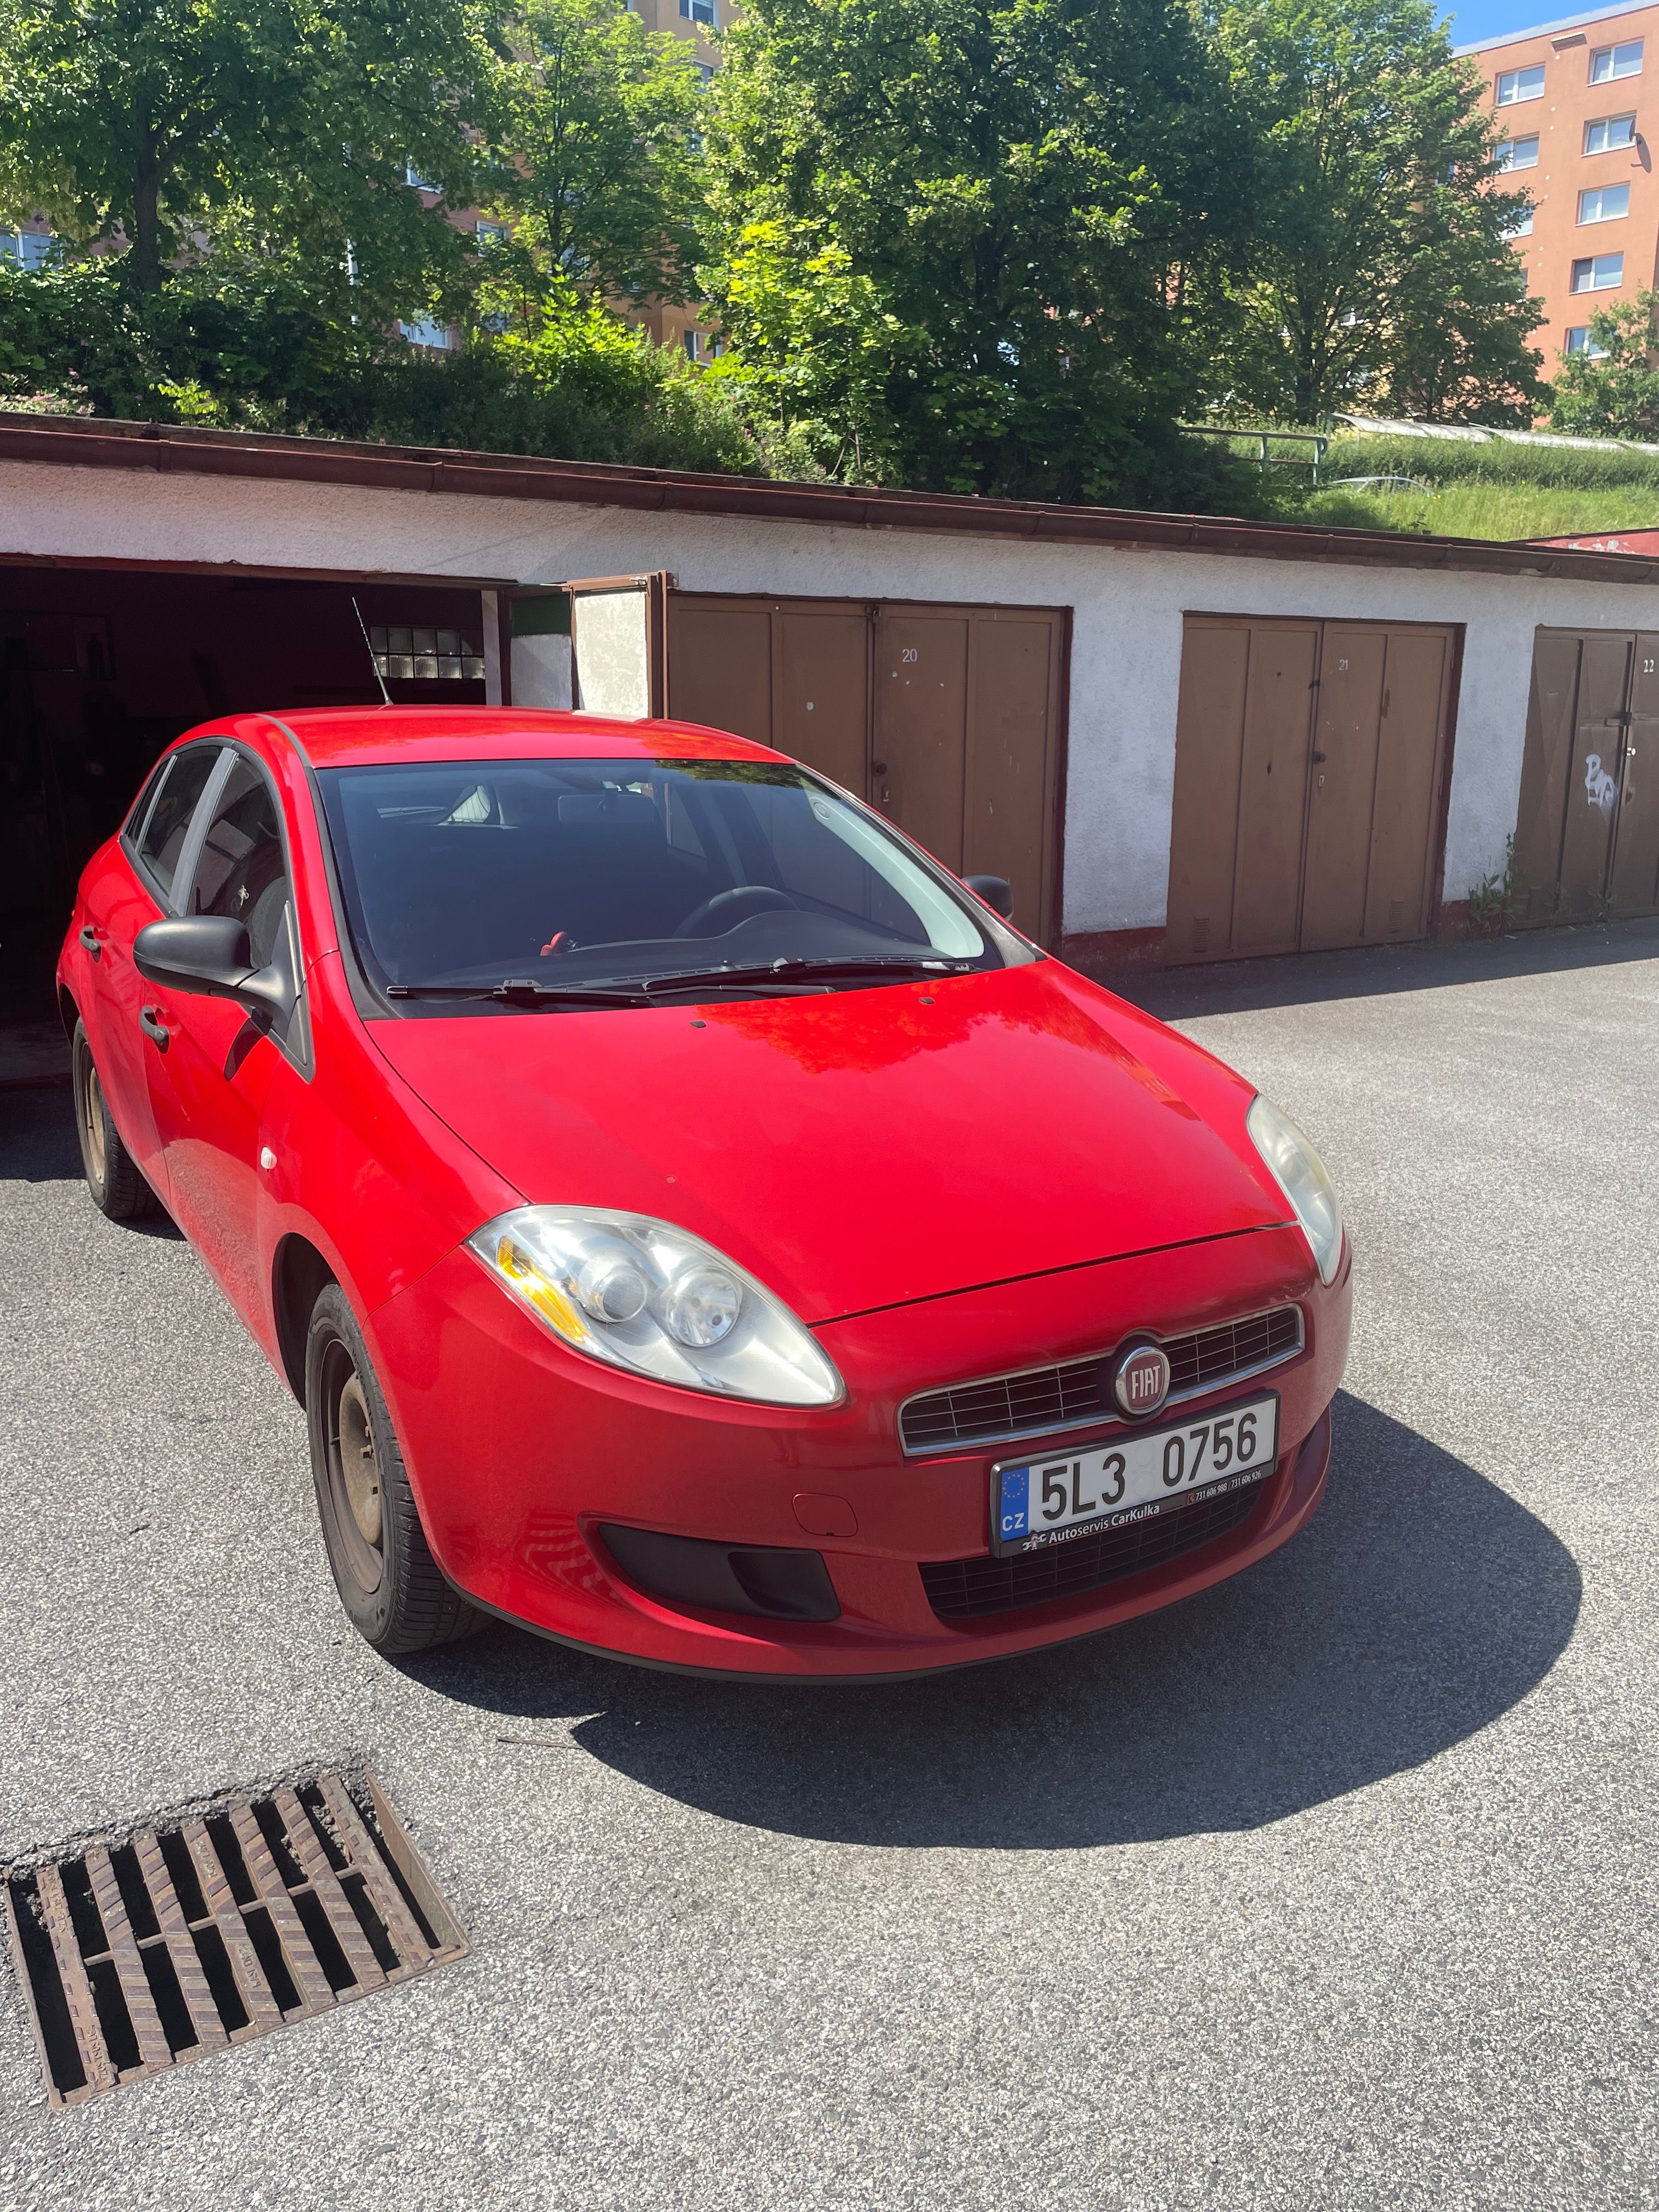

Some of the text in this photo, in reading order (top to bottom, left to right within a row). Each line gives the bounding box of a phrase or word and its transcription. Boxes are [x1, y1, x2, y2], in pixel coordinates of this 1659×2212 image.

[902, 648, 918, 662] 20
[1339, 659, 1348, 670] 21
[1643, 659, 1655, 673] 22
[1131, 1364, 1161, 1400] FIAT
[1041, 1412, 1257, 1521] 5L3 0756
[1195, 1490, 1205, 1501] 731
[1207, 1486, 1216, 1497] 606
[1231, 1477, 1240, 1488] 731
[1241, 1474, 1251, 1485] 606
[1251, 1470, 1261, 1481] 926
[1002, 1512, 1025, 1532] CZ
[1048, 1504, 1160, 1544] Autoservis CarKulka
